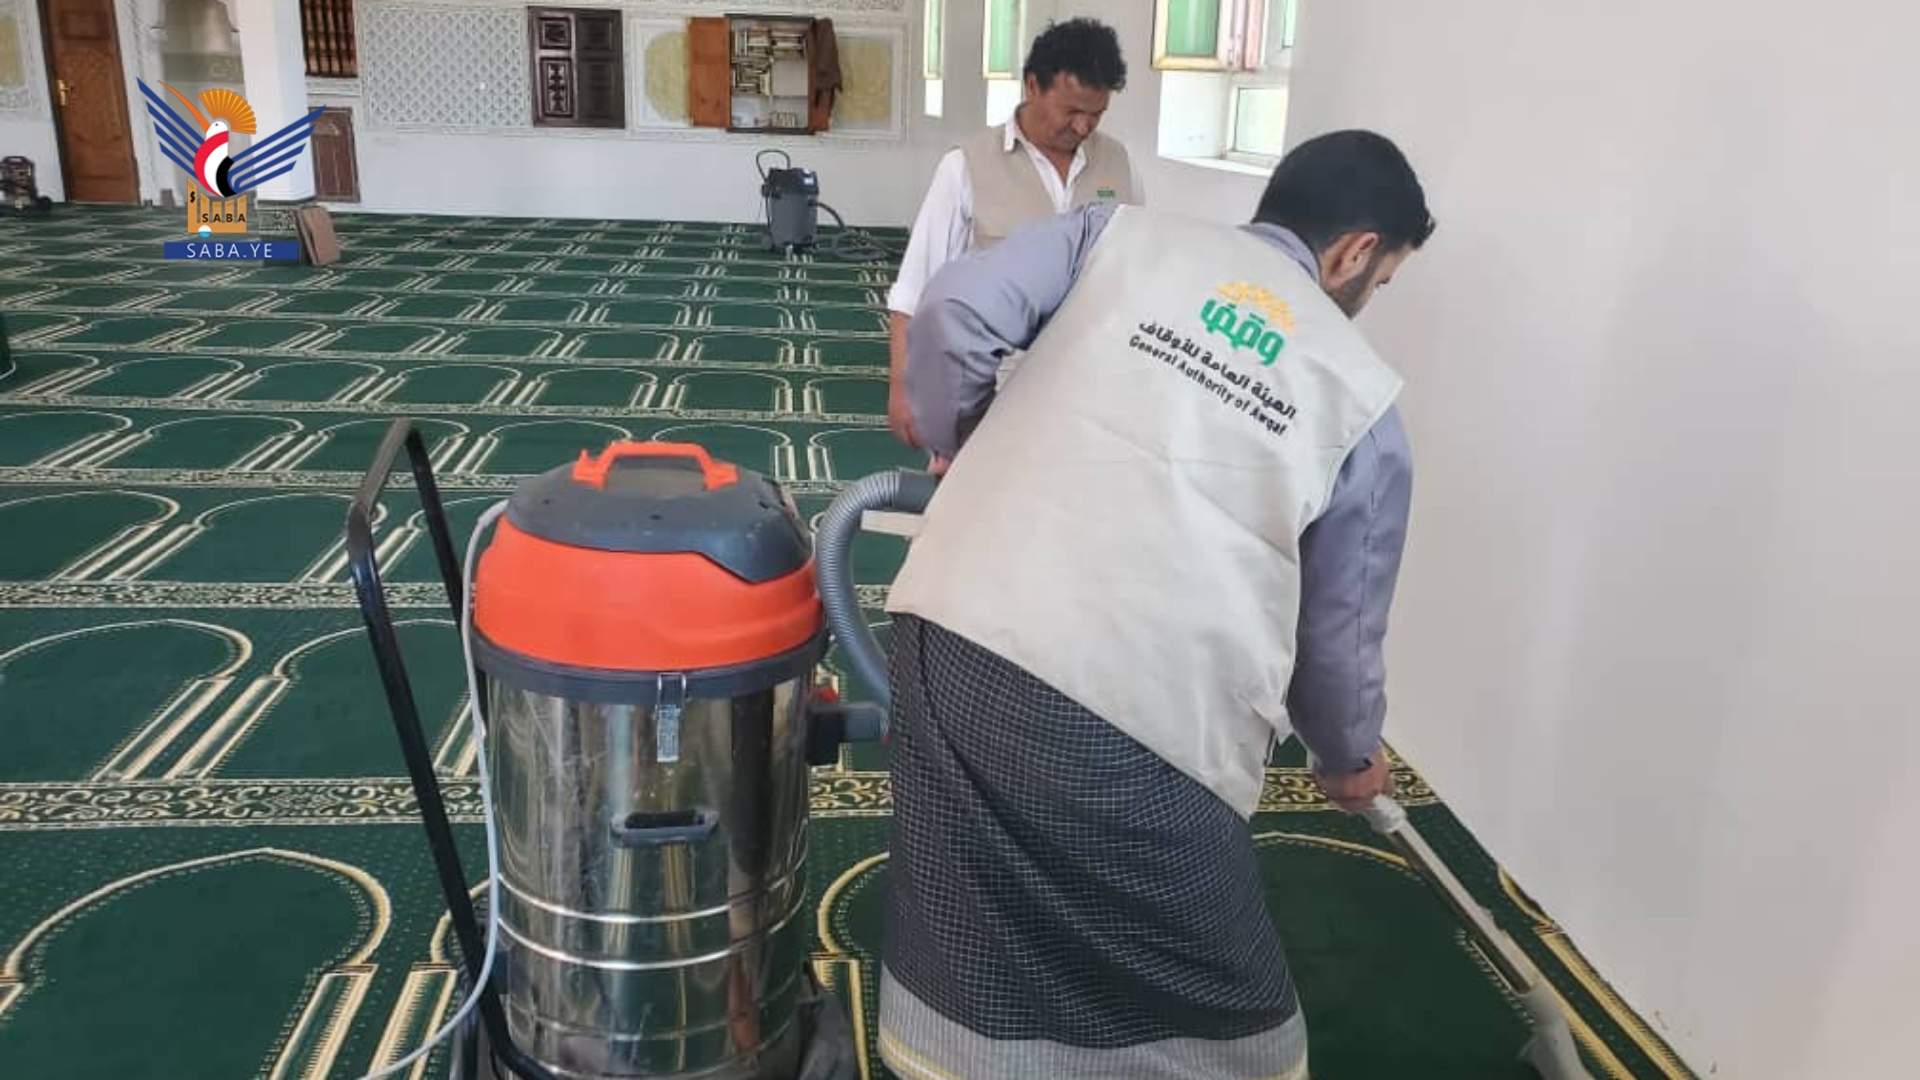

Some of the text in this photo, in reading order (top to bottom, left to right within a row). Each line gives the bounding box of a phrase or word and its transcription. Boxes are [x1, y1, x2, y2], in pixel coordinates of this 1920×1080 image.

[1129, 335, 1288, 436] General Authority of Awqaf
[1201, 352, 1250, 388] العامة
[1251, 382, 1297, 420] الهيئة
